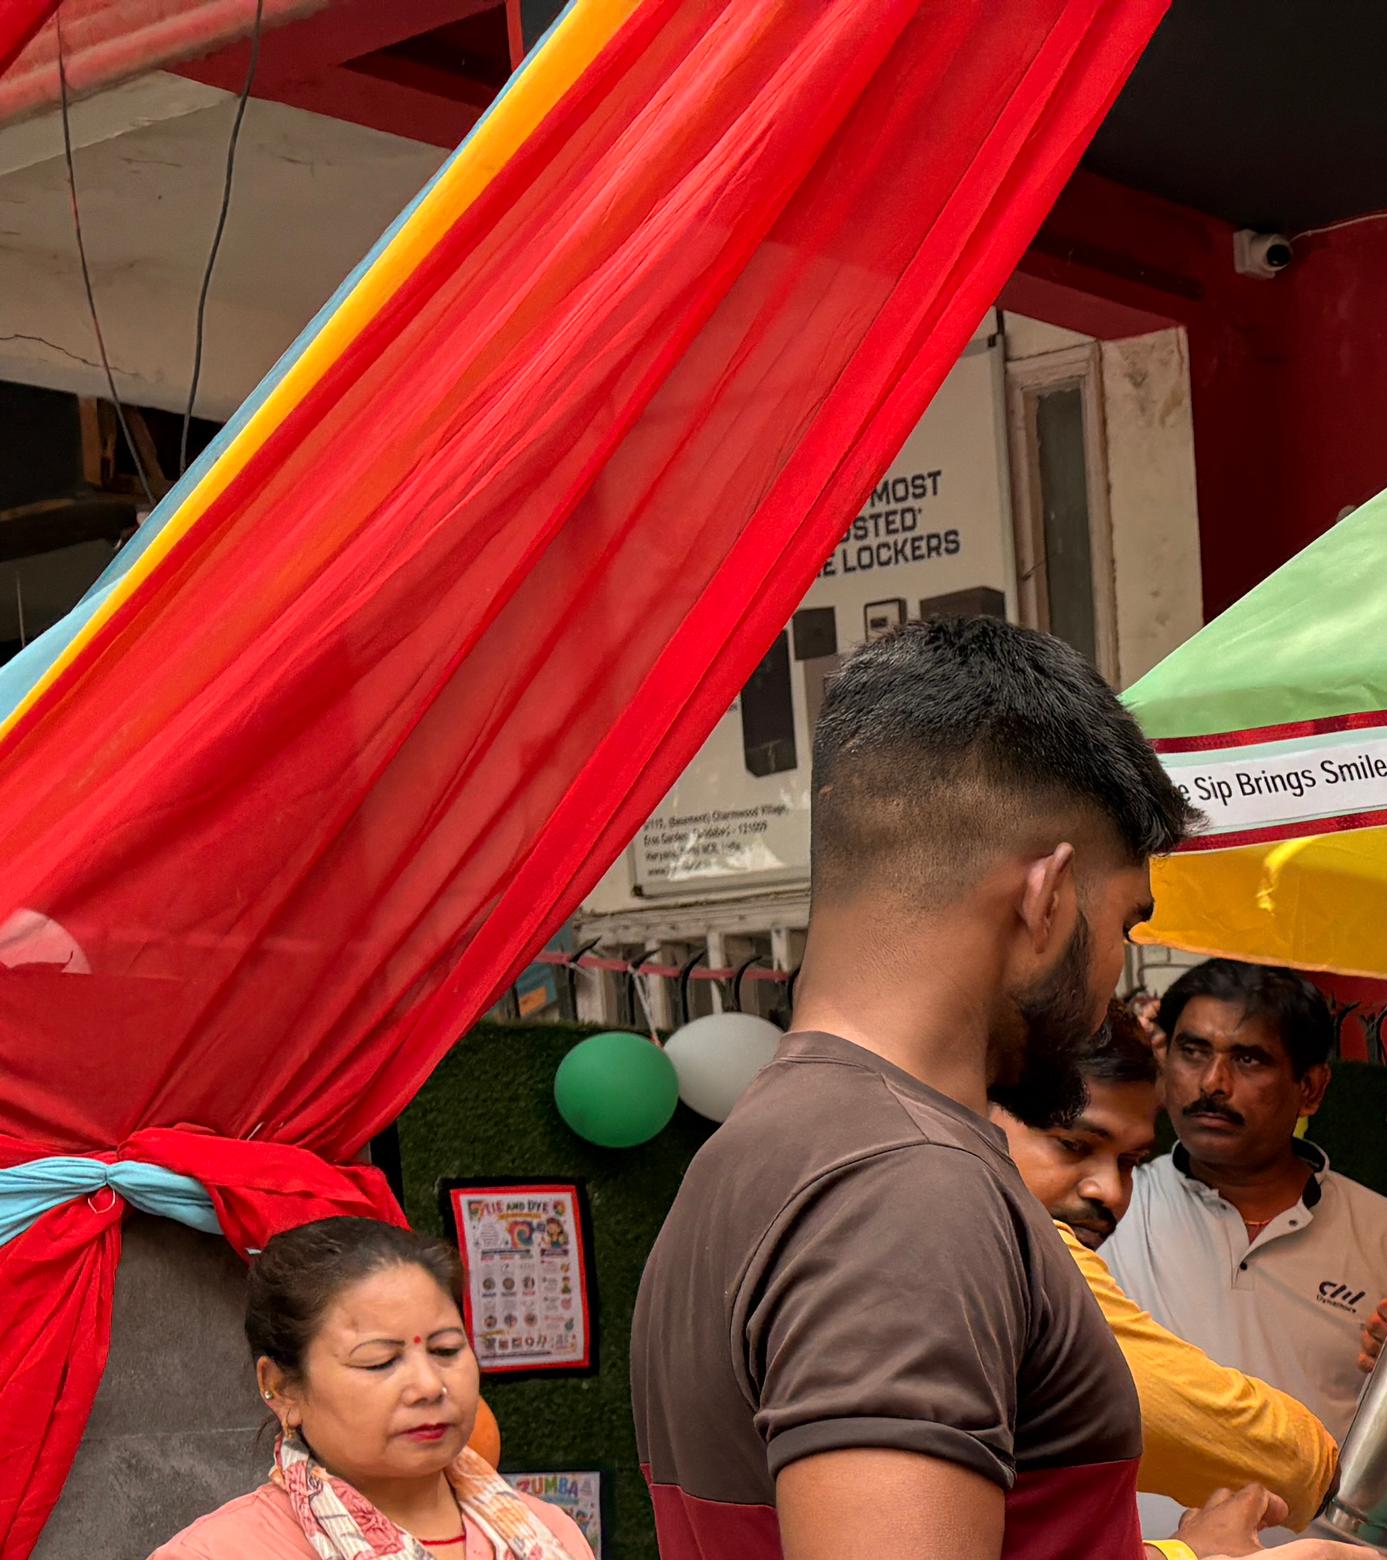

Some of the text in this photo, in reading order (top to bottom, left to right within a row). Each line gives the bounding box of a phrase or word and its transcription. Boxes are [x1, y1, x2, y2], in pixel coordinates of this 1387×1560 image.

[870, 470, 942, 507] MOST
[843, 529, 960, 573] LOCKERS
[1194, 775, 1232, 806] Sip
[1236, 769, 1317, 798] Brings
